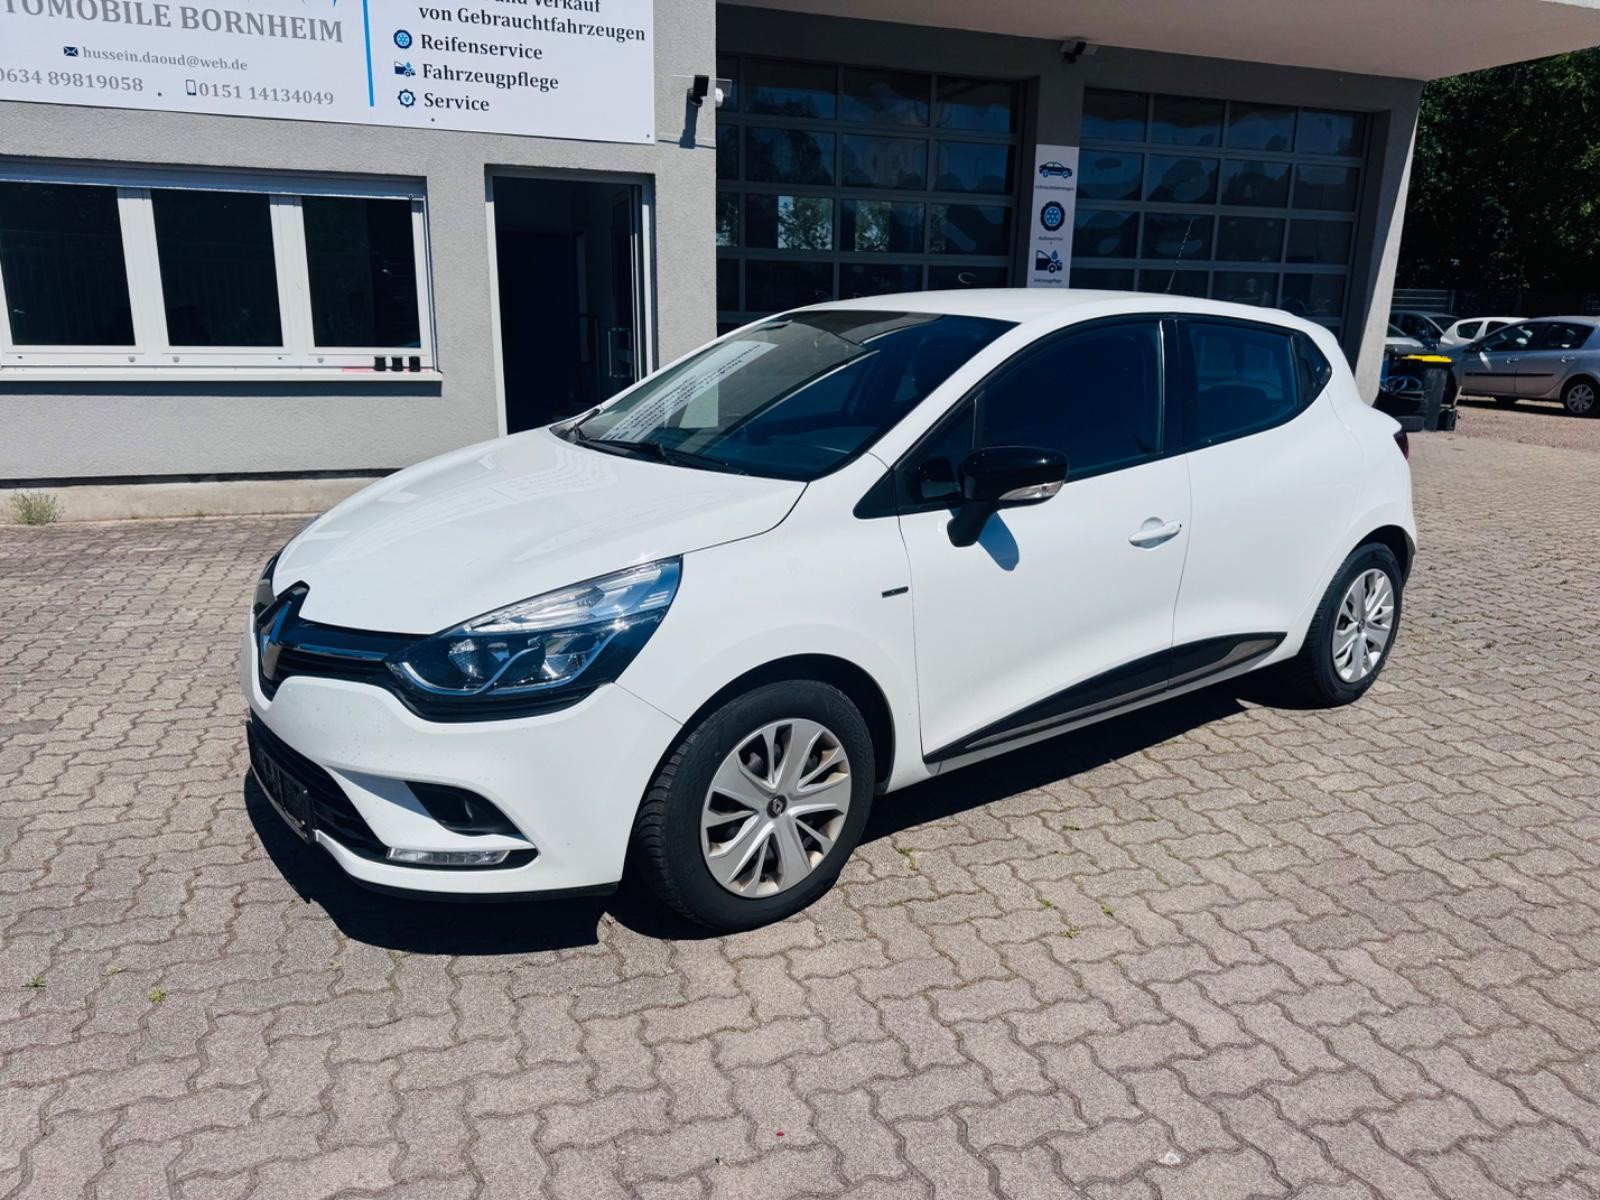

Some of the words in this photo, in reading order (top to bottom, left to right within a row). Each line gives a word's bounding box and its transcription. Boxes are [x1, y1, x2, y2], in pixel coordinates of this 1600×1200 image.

[180, 7, 343, 43] BORNHEIM
[419, 7, 452, 21] von
[457, 7, 646, 42] Gebrauchtfahrzeugen
[83, 47, 247, 70] hussein.daoud@web.de
[421, 34, 543, 60] Reifenservice
[48, 72, 143, 91] 89819058
[422, 64, 558, 92] Fahrzeugpflege
[199, 83, 241, 98] 0151
[249, 87, 333, 104] 14134049
[424, 93, 490, 111] Service
